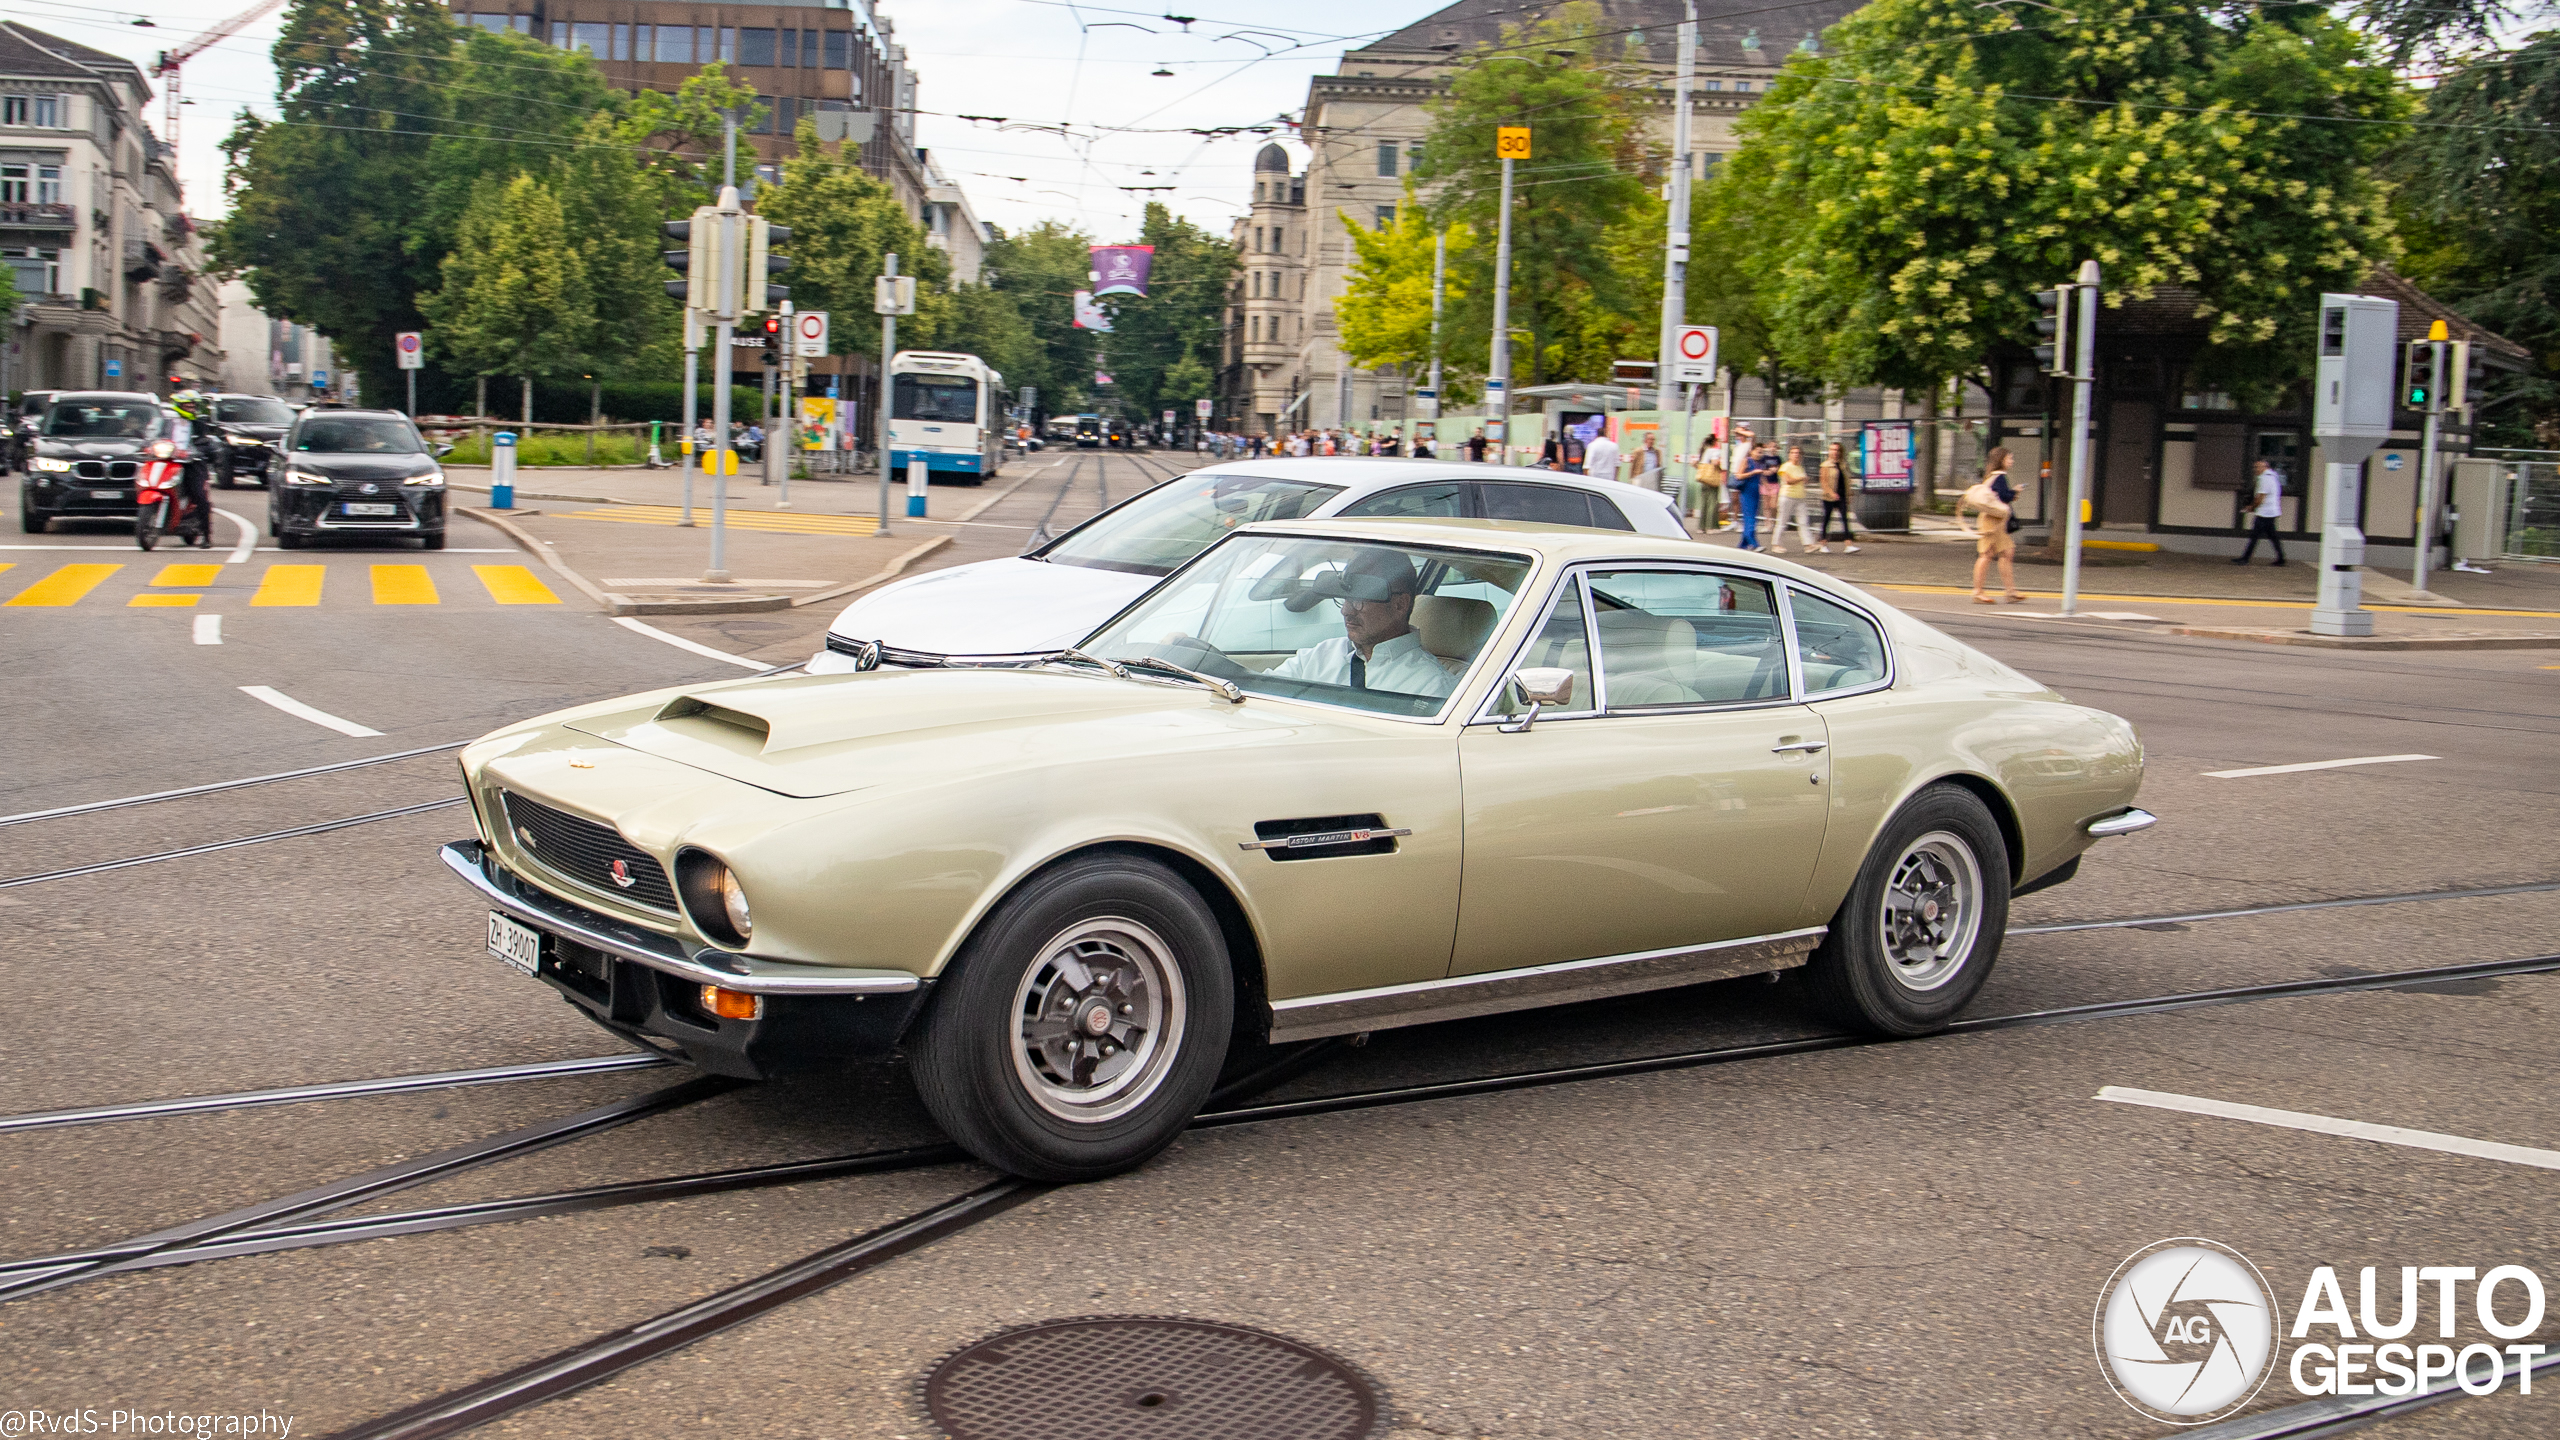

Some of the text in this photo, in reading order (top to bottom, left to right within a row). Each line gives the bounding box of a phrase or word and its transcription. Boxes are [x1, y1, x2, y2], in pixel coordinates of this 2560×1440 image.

[1500, 135, 1530, 152] 30
[1291, 831, 1370, 845] ASTON MARTIN V8
